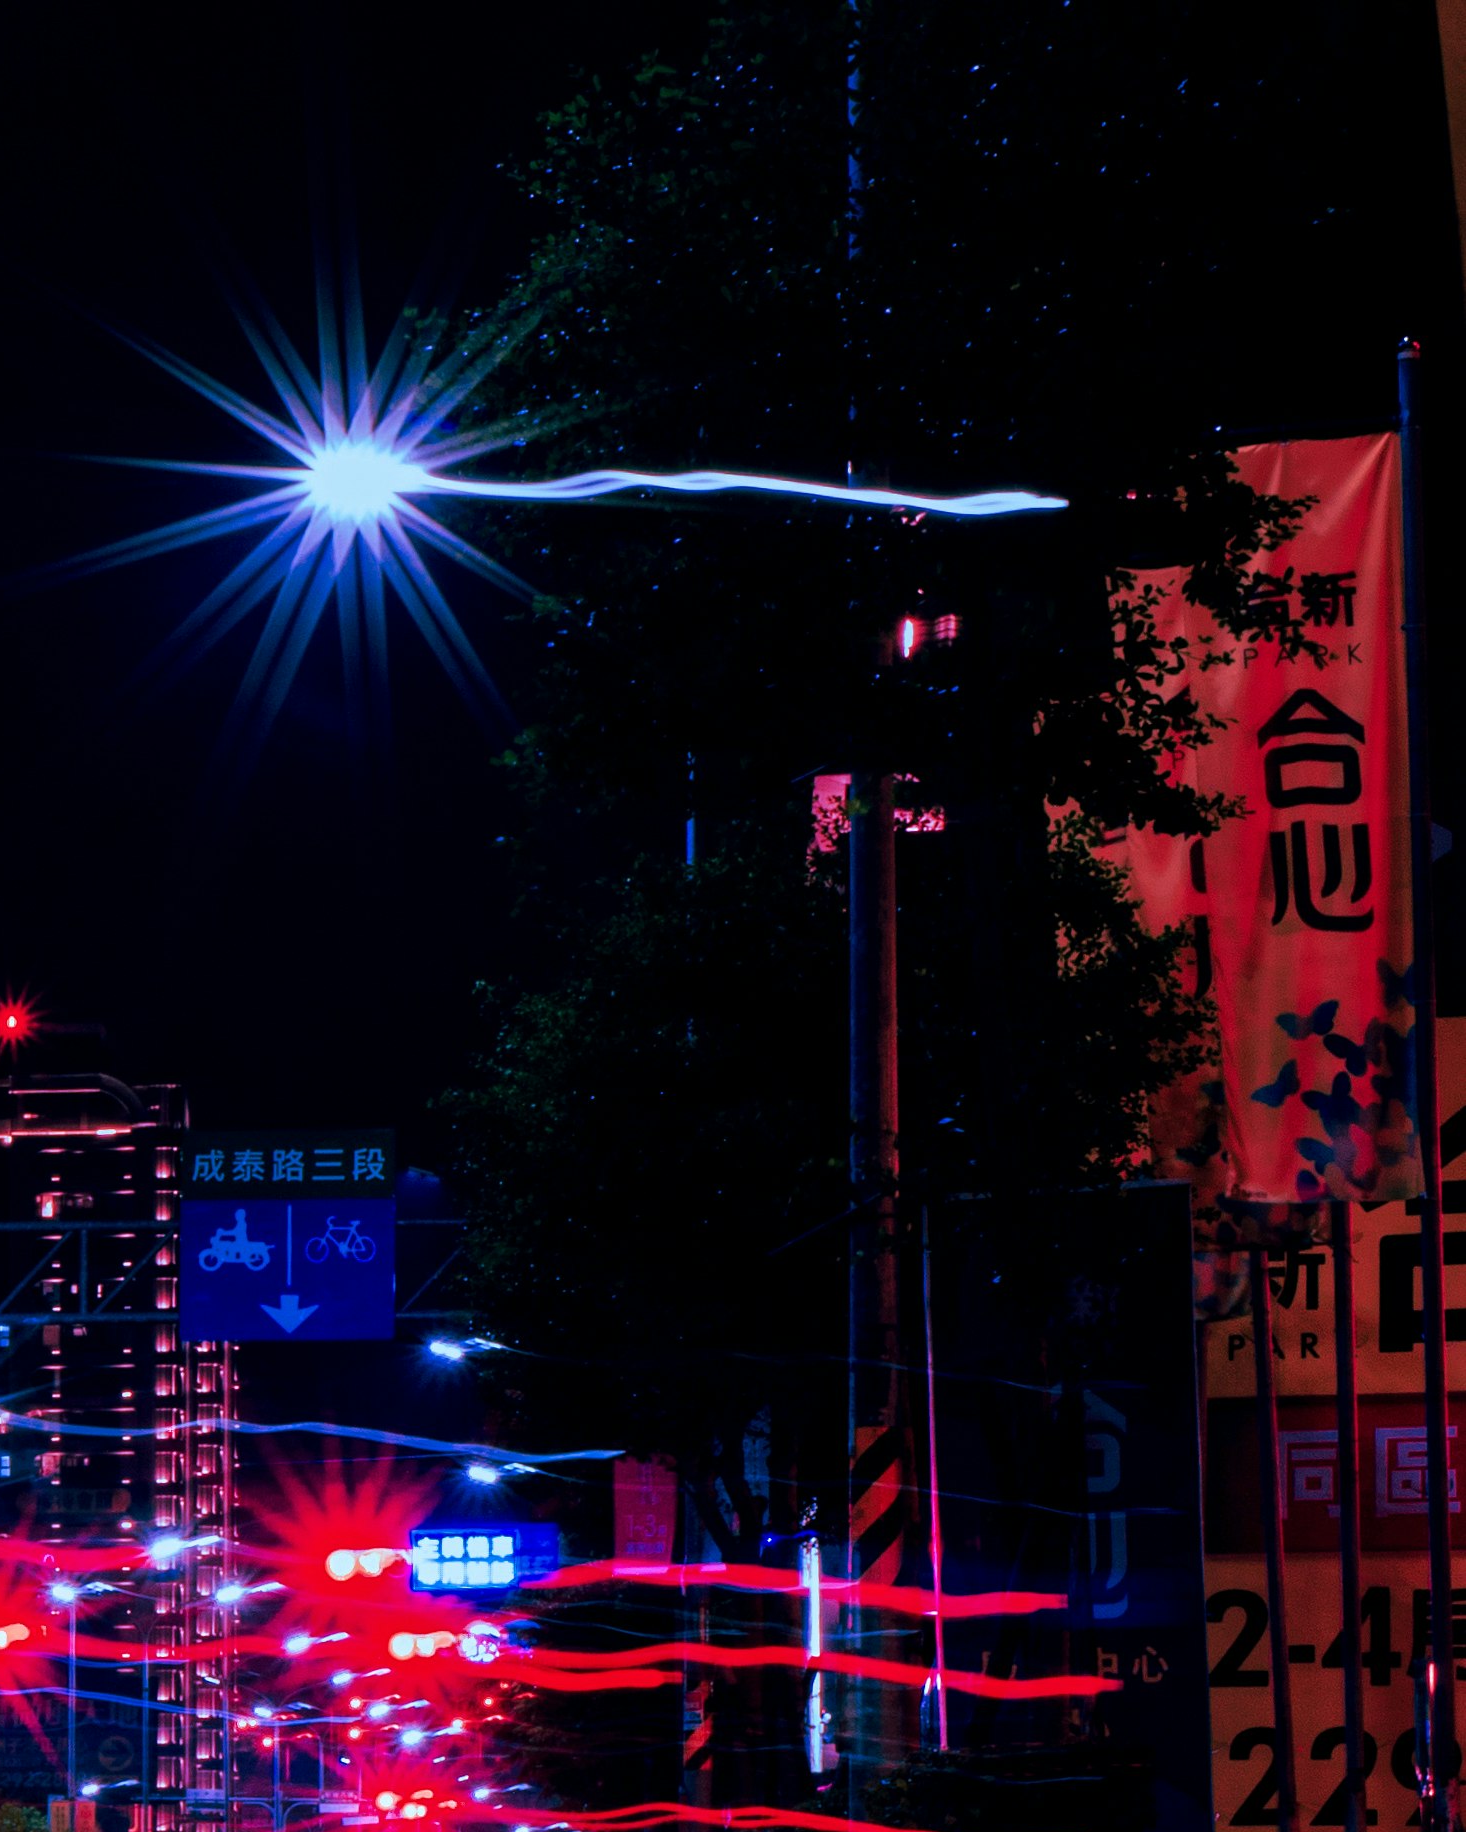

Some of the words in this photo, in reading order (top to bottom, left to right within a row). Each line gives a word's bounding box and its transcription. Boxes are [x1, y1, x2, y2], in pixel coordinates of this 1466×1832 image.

[1243, 643, 1362, 668] PARK
[1257, 688, 1375, 932] 合心
[192, 1148, 385, 1182] 成泰路三段
